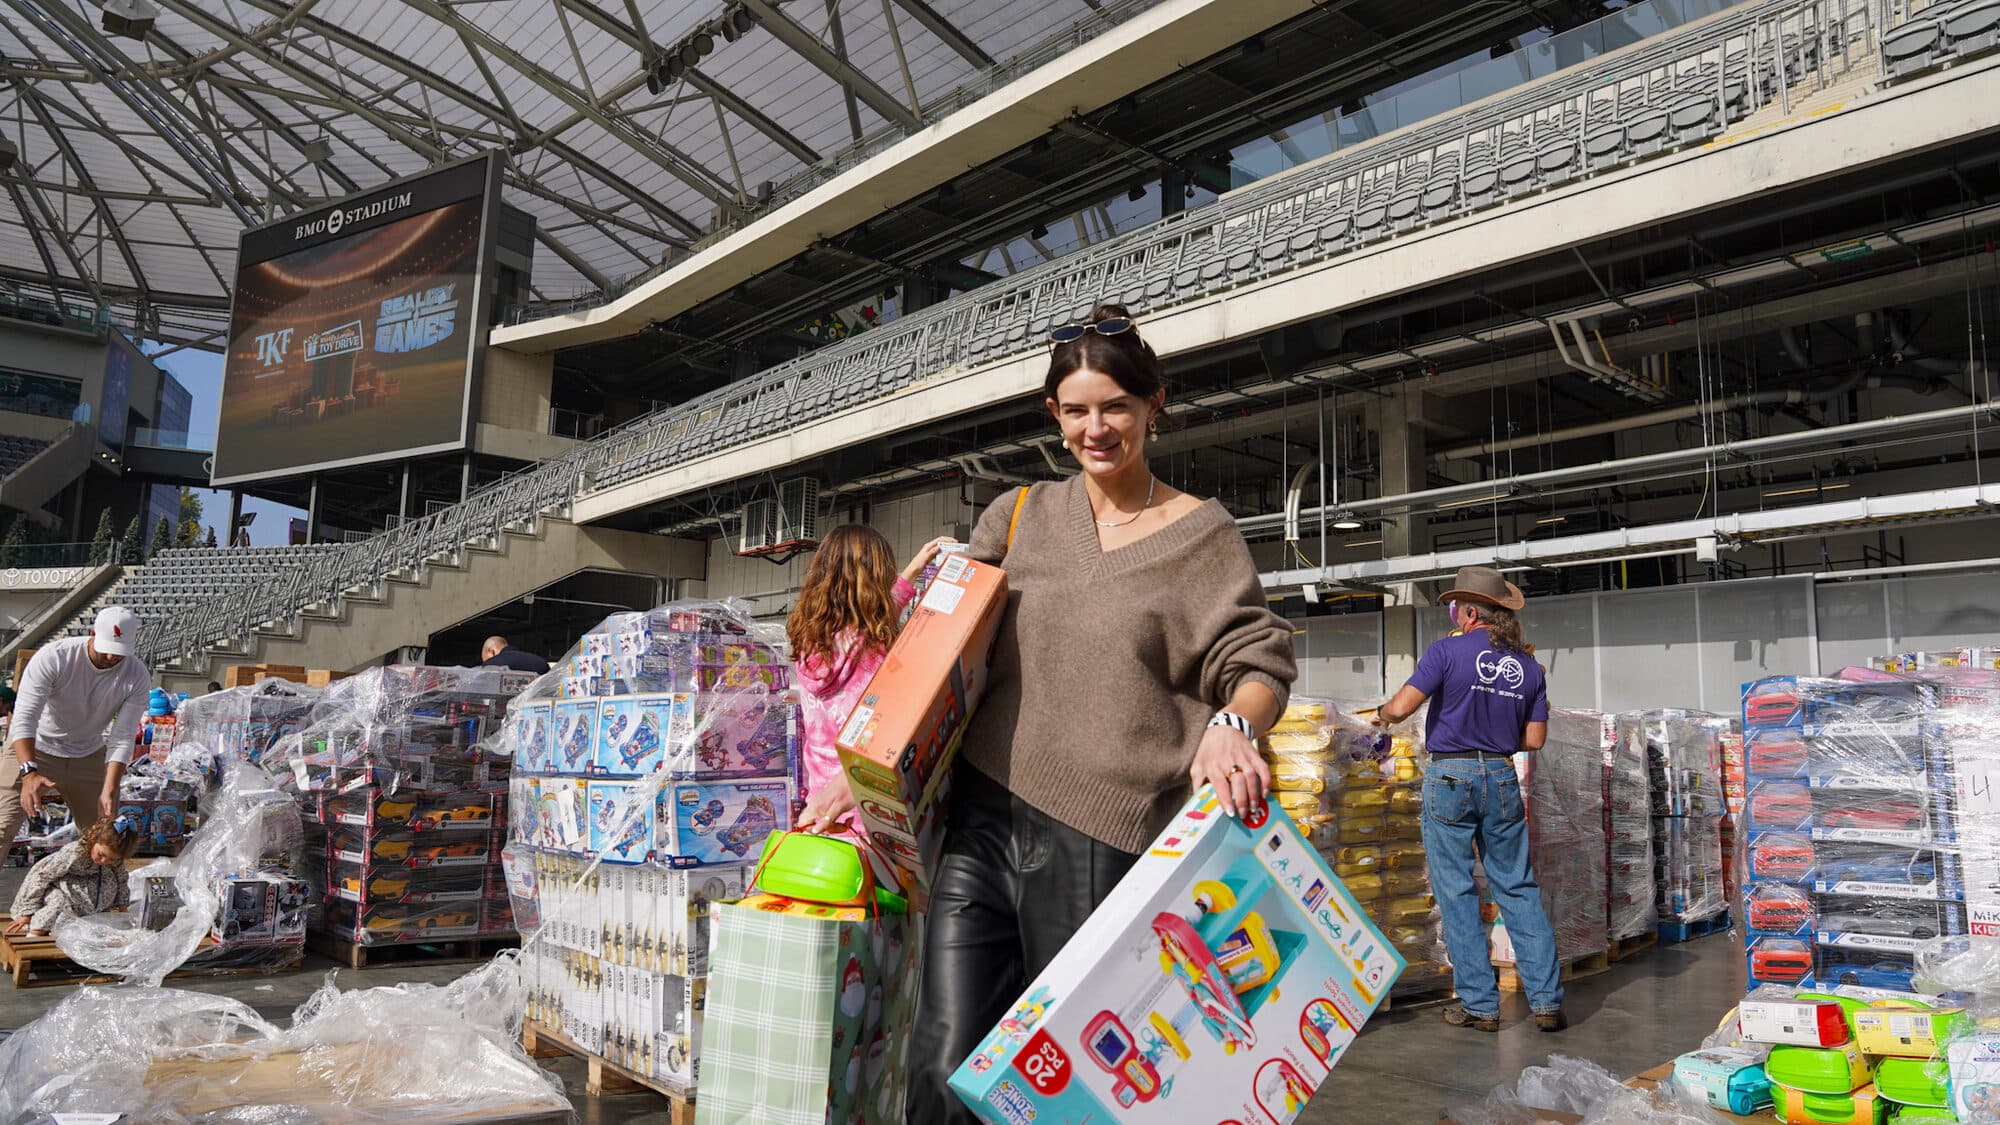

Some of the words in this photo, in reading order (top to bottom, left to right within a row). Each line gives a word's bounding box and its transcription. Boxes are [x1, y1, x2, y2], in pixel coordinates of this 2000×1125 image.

[295, 219, 326, 240] BMO
[345, 192, 412, 225] STADIUM
[380, 283, 456, 316] REALITY
[256, 328, 294, 367] TKF
[319, 342, 334, 354] TOY
[334, 335, 360, 351] DRIVE
[375, 311, 456, 353] GAMES
[23, 569, 77, 584] TOYOTA
[1871, 937, 1887, 945] FORD
[1025, 1053, 1056, 1087] 20
[1040, 1041, 1065, 1070] PCS
[1282, 1045, 1299, 1065] Faucet
[987, 1088, 1031, 1125] MAGINE
[1003, 1085, 1032, 1114] ZONE
